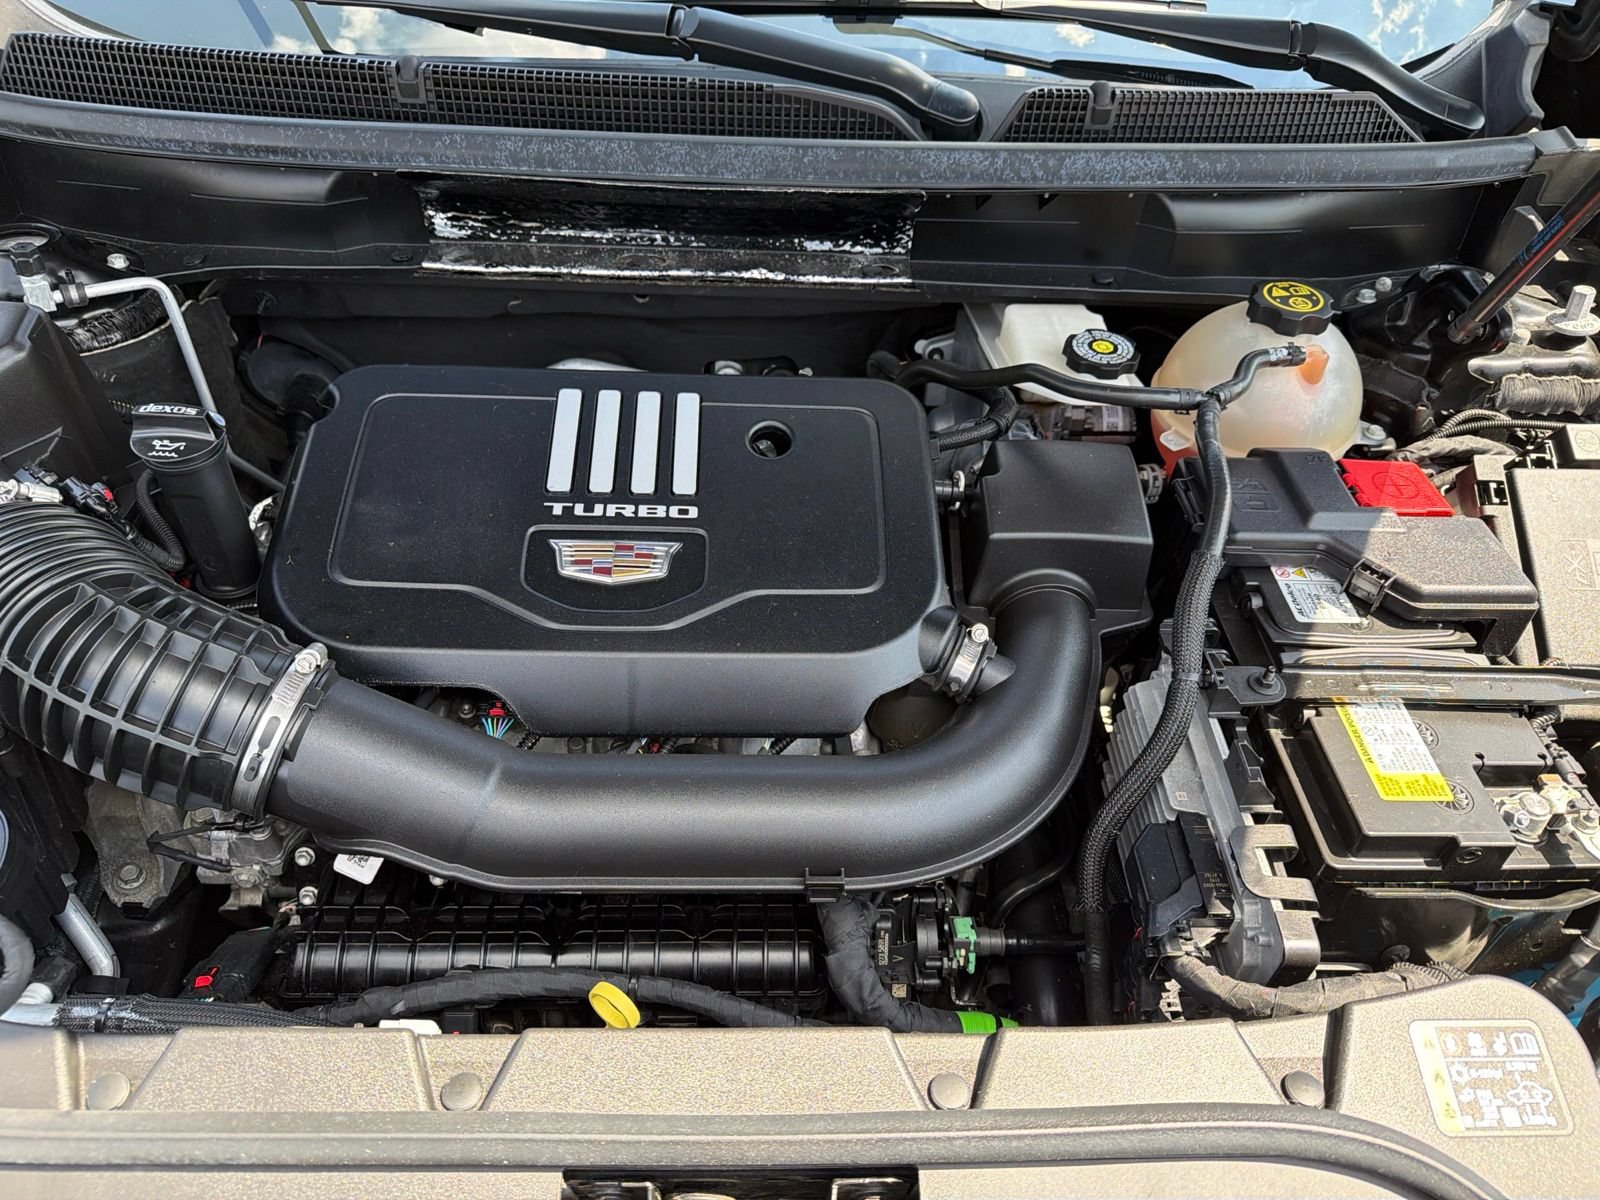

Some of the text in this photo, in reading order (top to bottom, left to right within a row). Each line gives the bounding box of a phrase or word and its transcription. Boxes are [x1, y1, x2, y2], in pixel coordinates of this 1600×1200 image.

[138, 403, 200, 416] dexos
[543, 502, 699, 519] TURBO
[1352, 729, 1371, 758] DANGER
